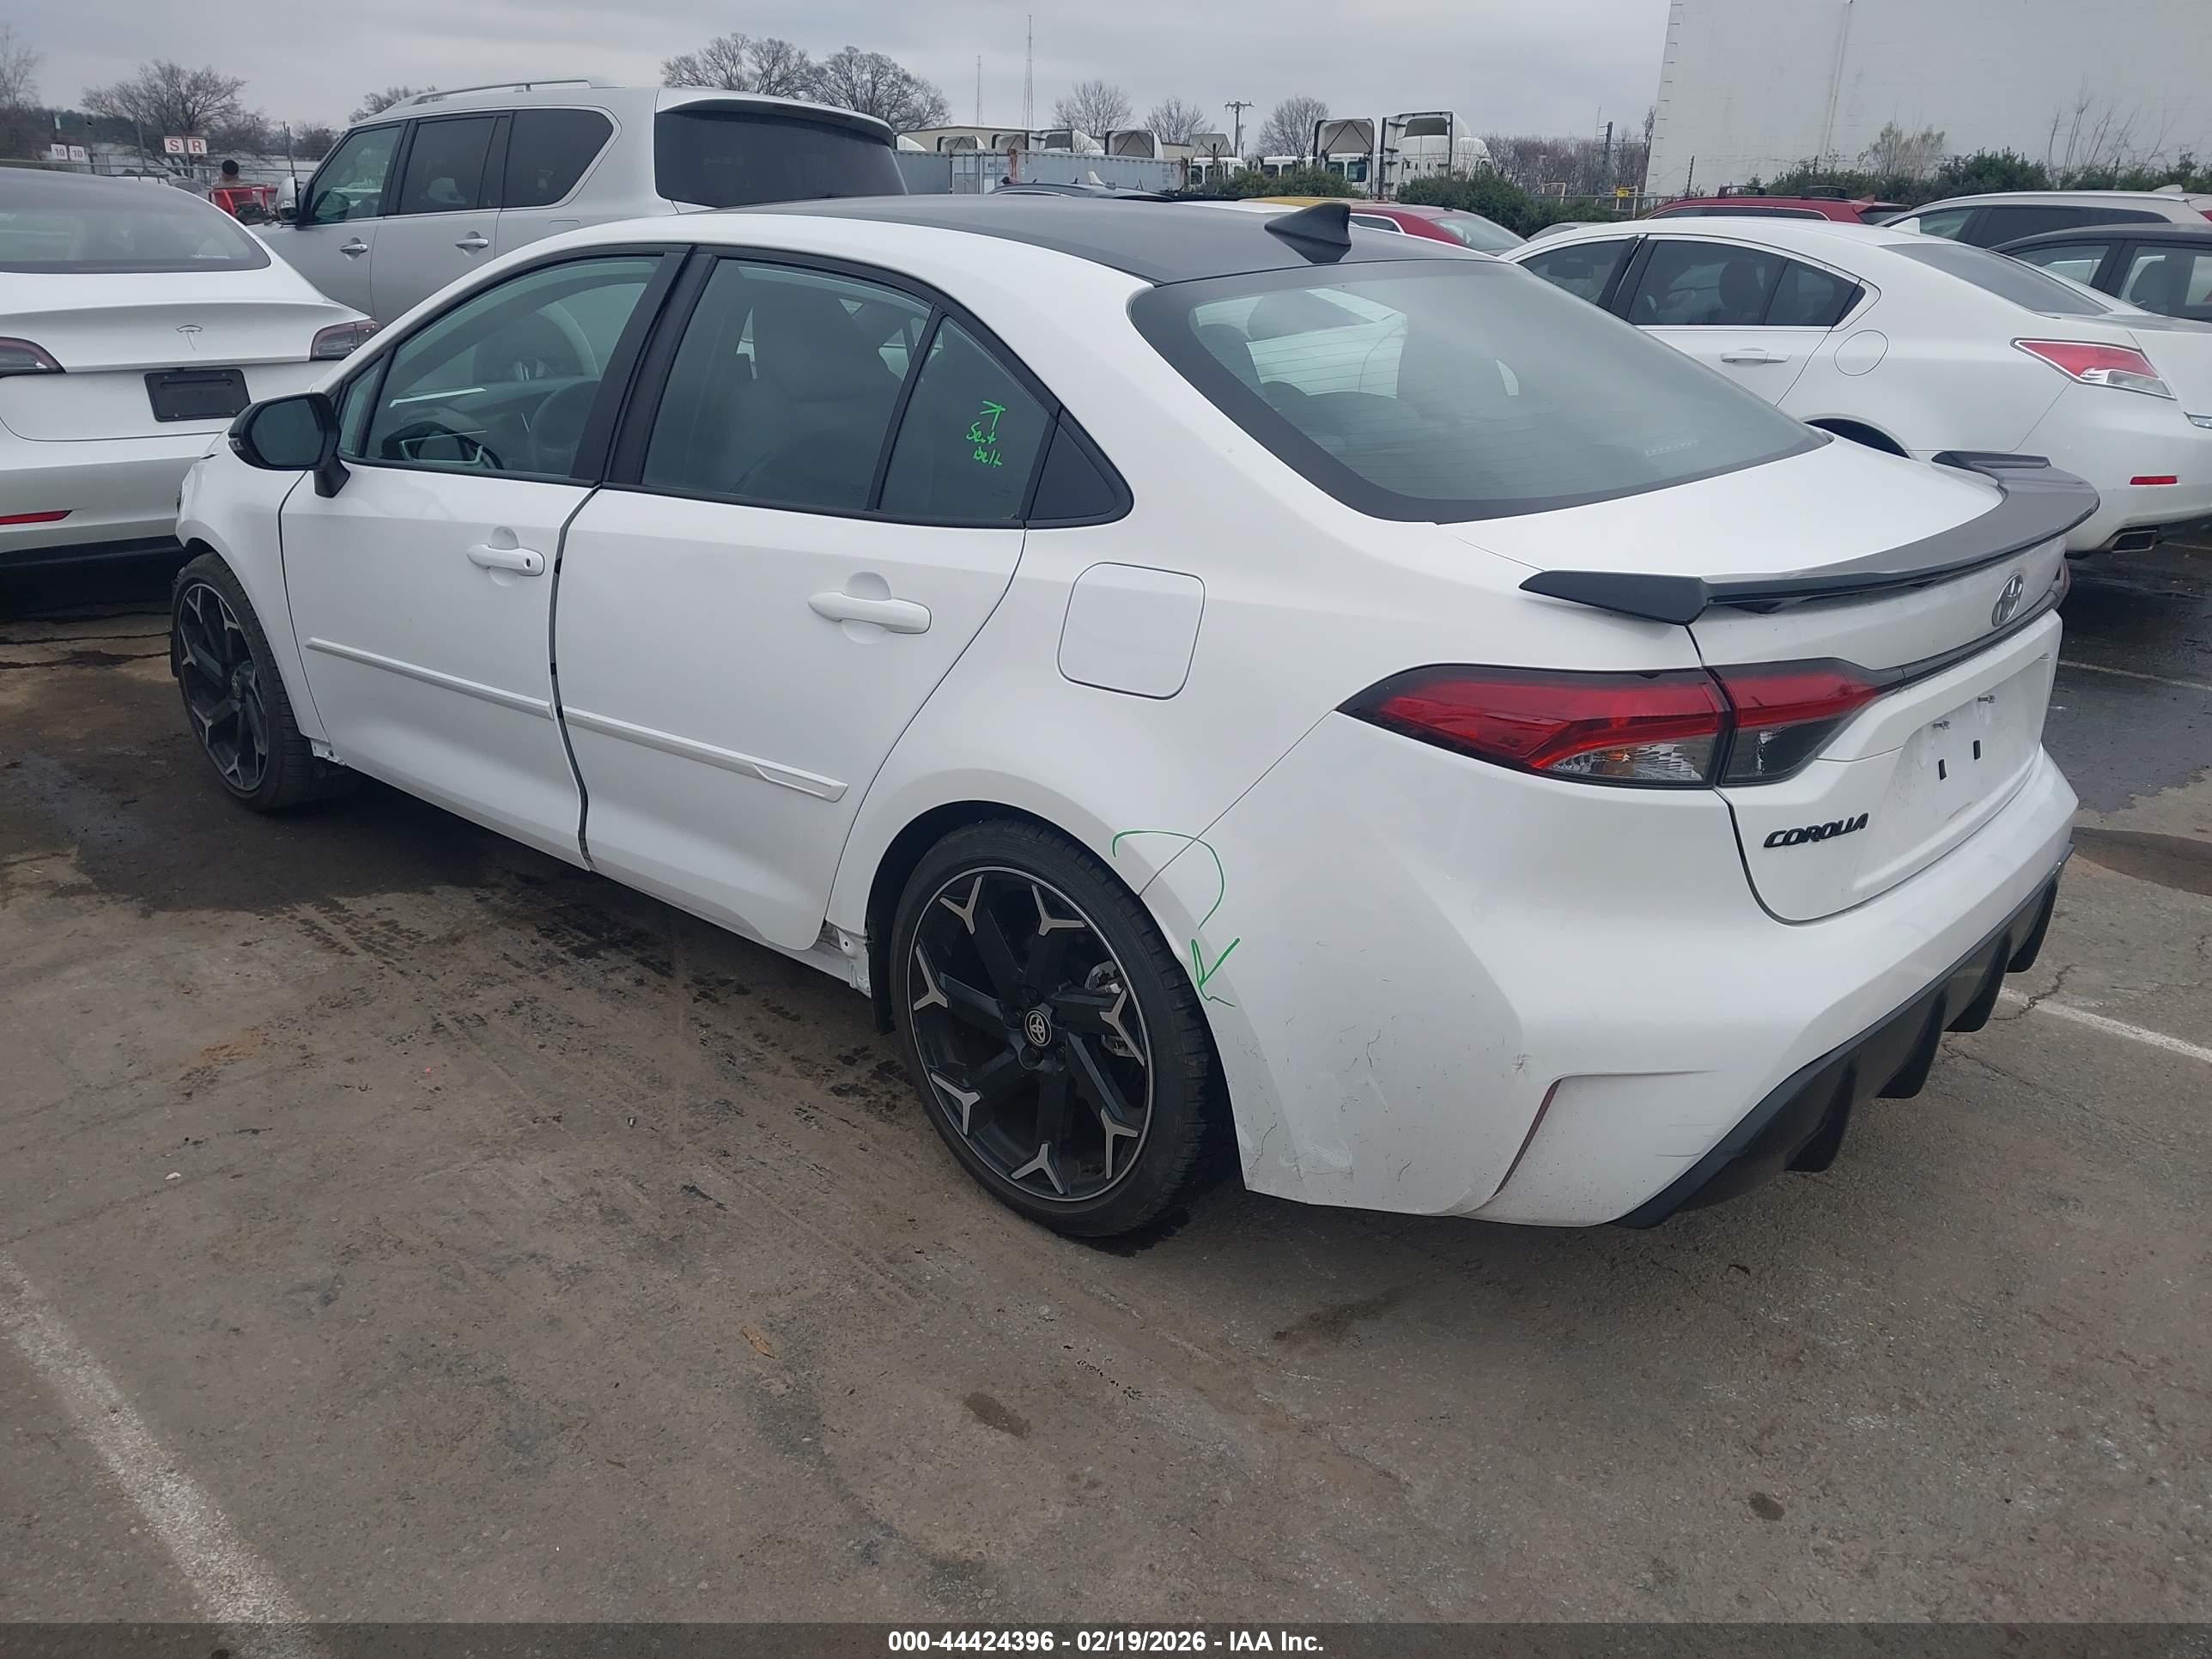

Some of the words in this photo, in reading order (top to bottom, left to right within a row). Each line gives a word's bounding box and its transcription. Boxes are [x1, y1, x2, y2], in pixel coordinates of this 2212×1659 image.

[169, 140, 179, 152] S
[191, 140, 203, 152] R
[1764, 812, 1869, 848] COROLLA
